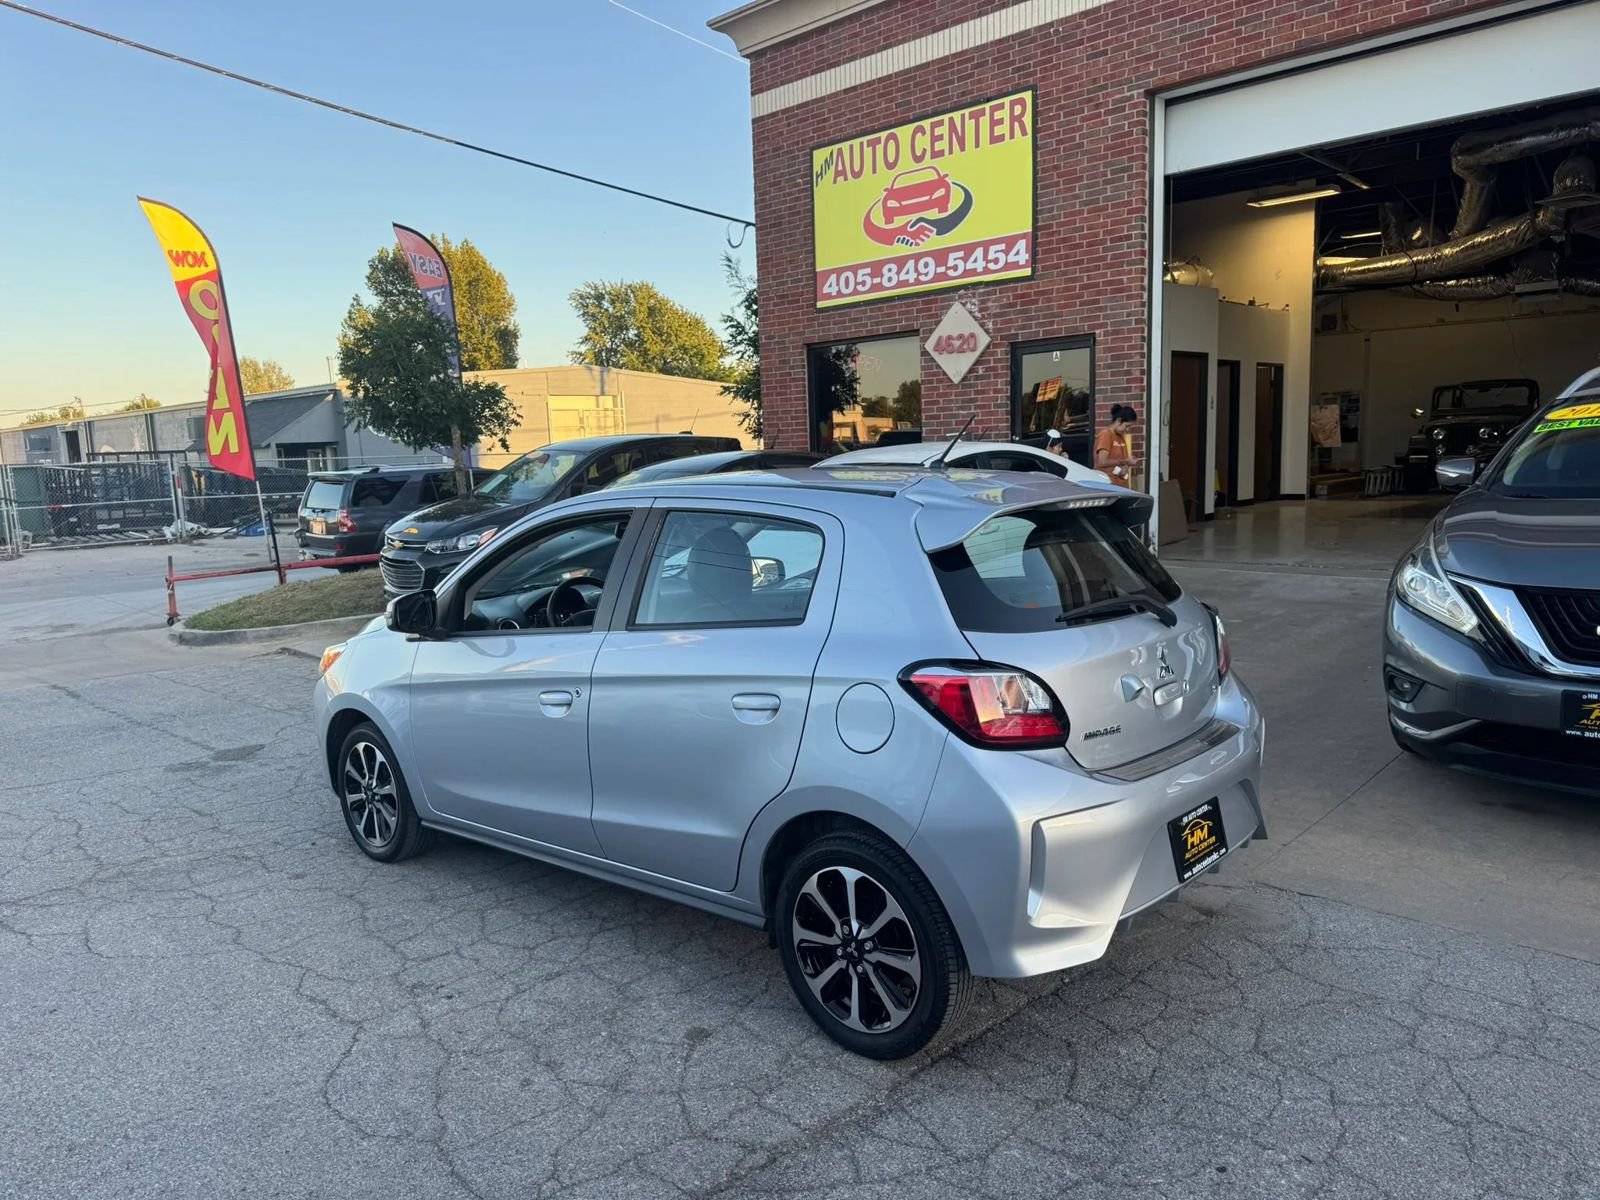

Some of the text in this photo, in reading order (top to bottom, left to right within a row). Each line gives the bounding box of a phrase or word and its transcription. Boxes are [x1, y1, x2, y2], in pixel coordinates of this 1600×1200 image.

[815, 96, 1029, 188] HM AUTO CENTER
[822, 238, 1029, 297] 405-849-5454
[932, 331, 980, 355] 4620
[1053, 351, 1060, 361] A
[1537, 421, 1571, 431] BEST
[1184, 847, 1199, 860] AUTO
[1198, 836, 1216, 851] CENTER
[1187, 824, 1208, 850] HM
